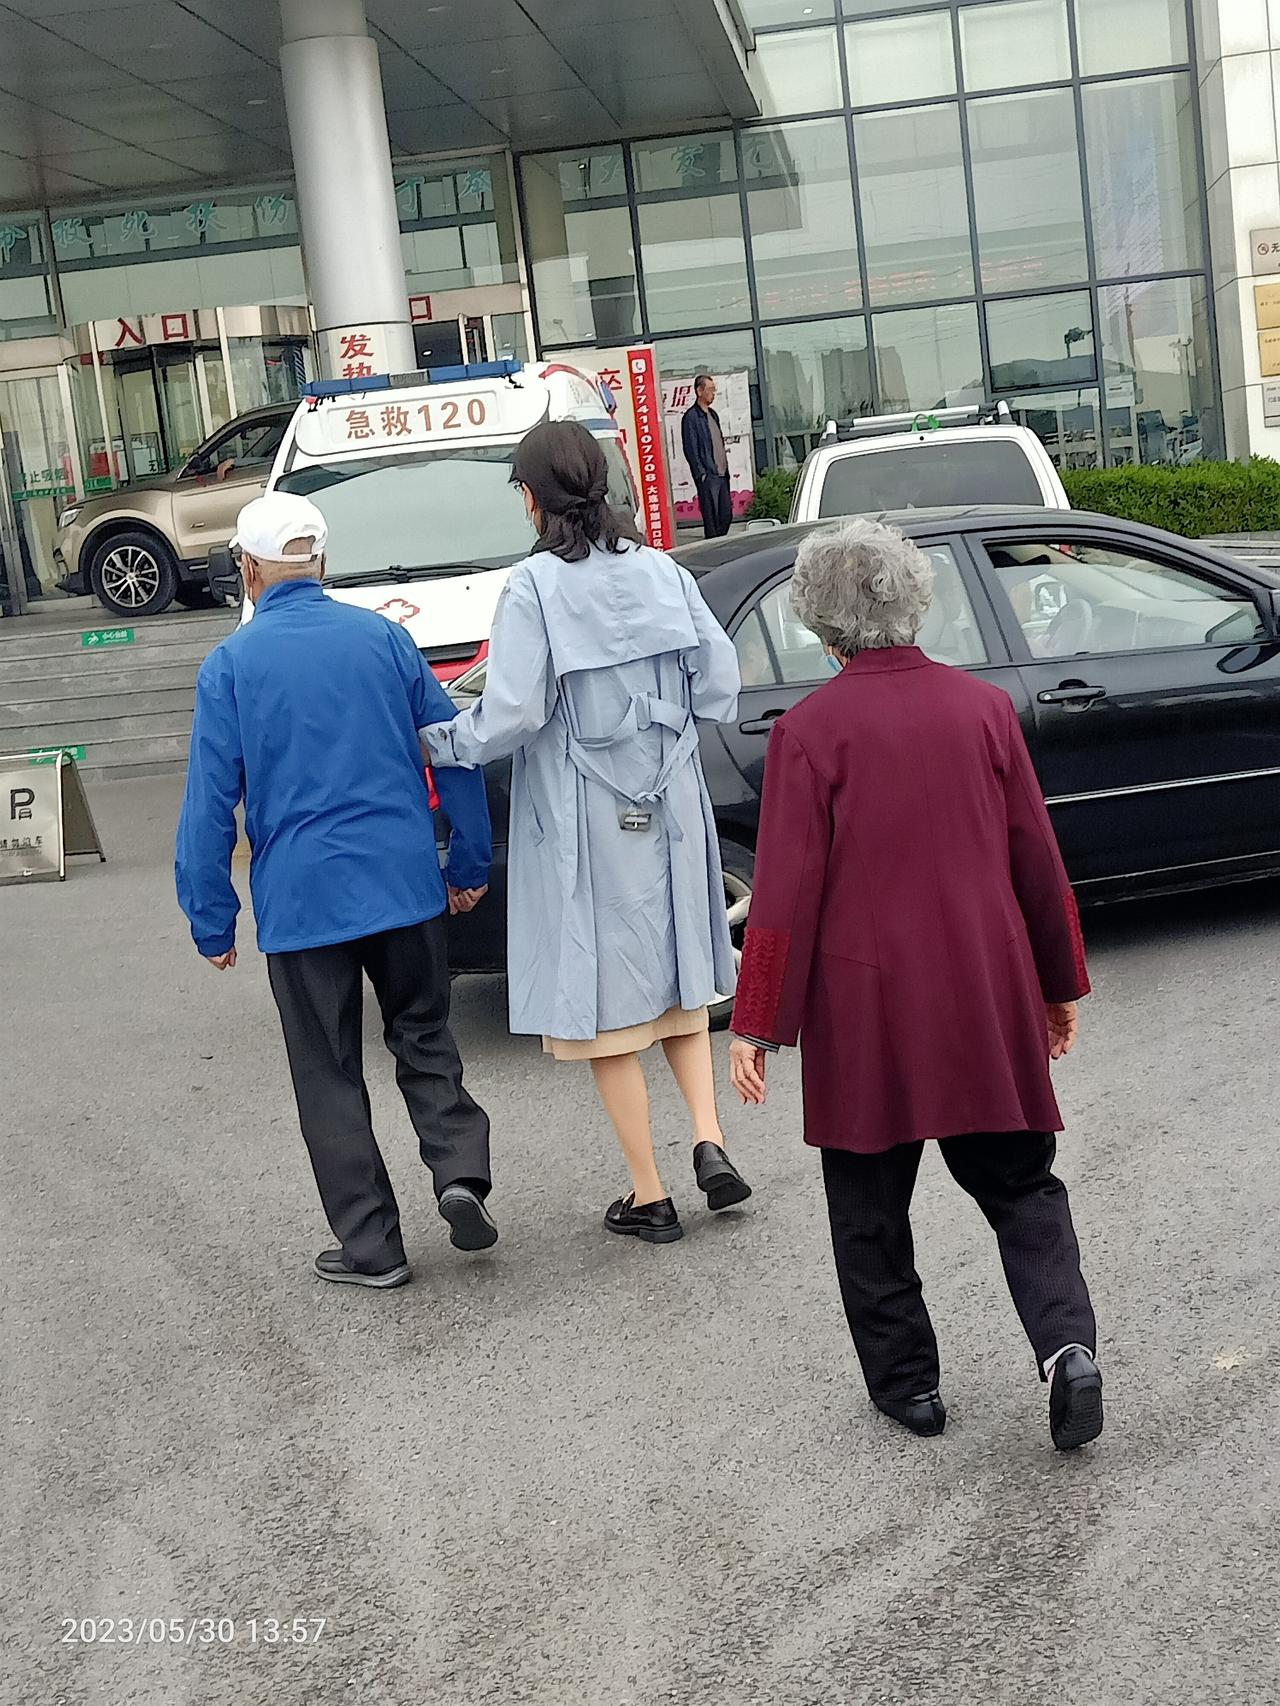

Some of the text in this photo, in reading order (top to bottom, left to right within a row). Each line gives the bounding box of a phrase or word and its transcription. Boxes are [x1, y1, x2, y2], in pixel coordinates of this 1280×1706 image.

[115, 313, 190, 348] 入口
[345, 398, 487, 440] 急救120
[634, 375, 657, 483] 17741107708
